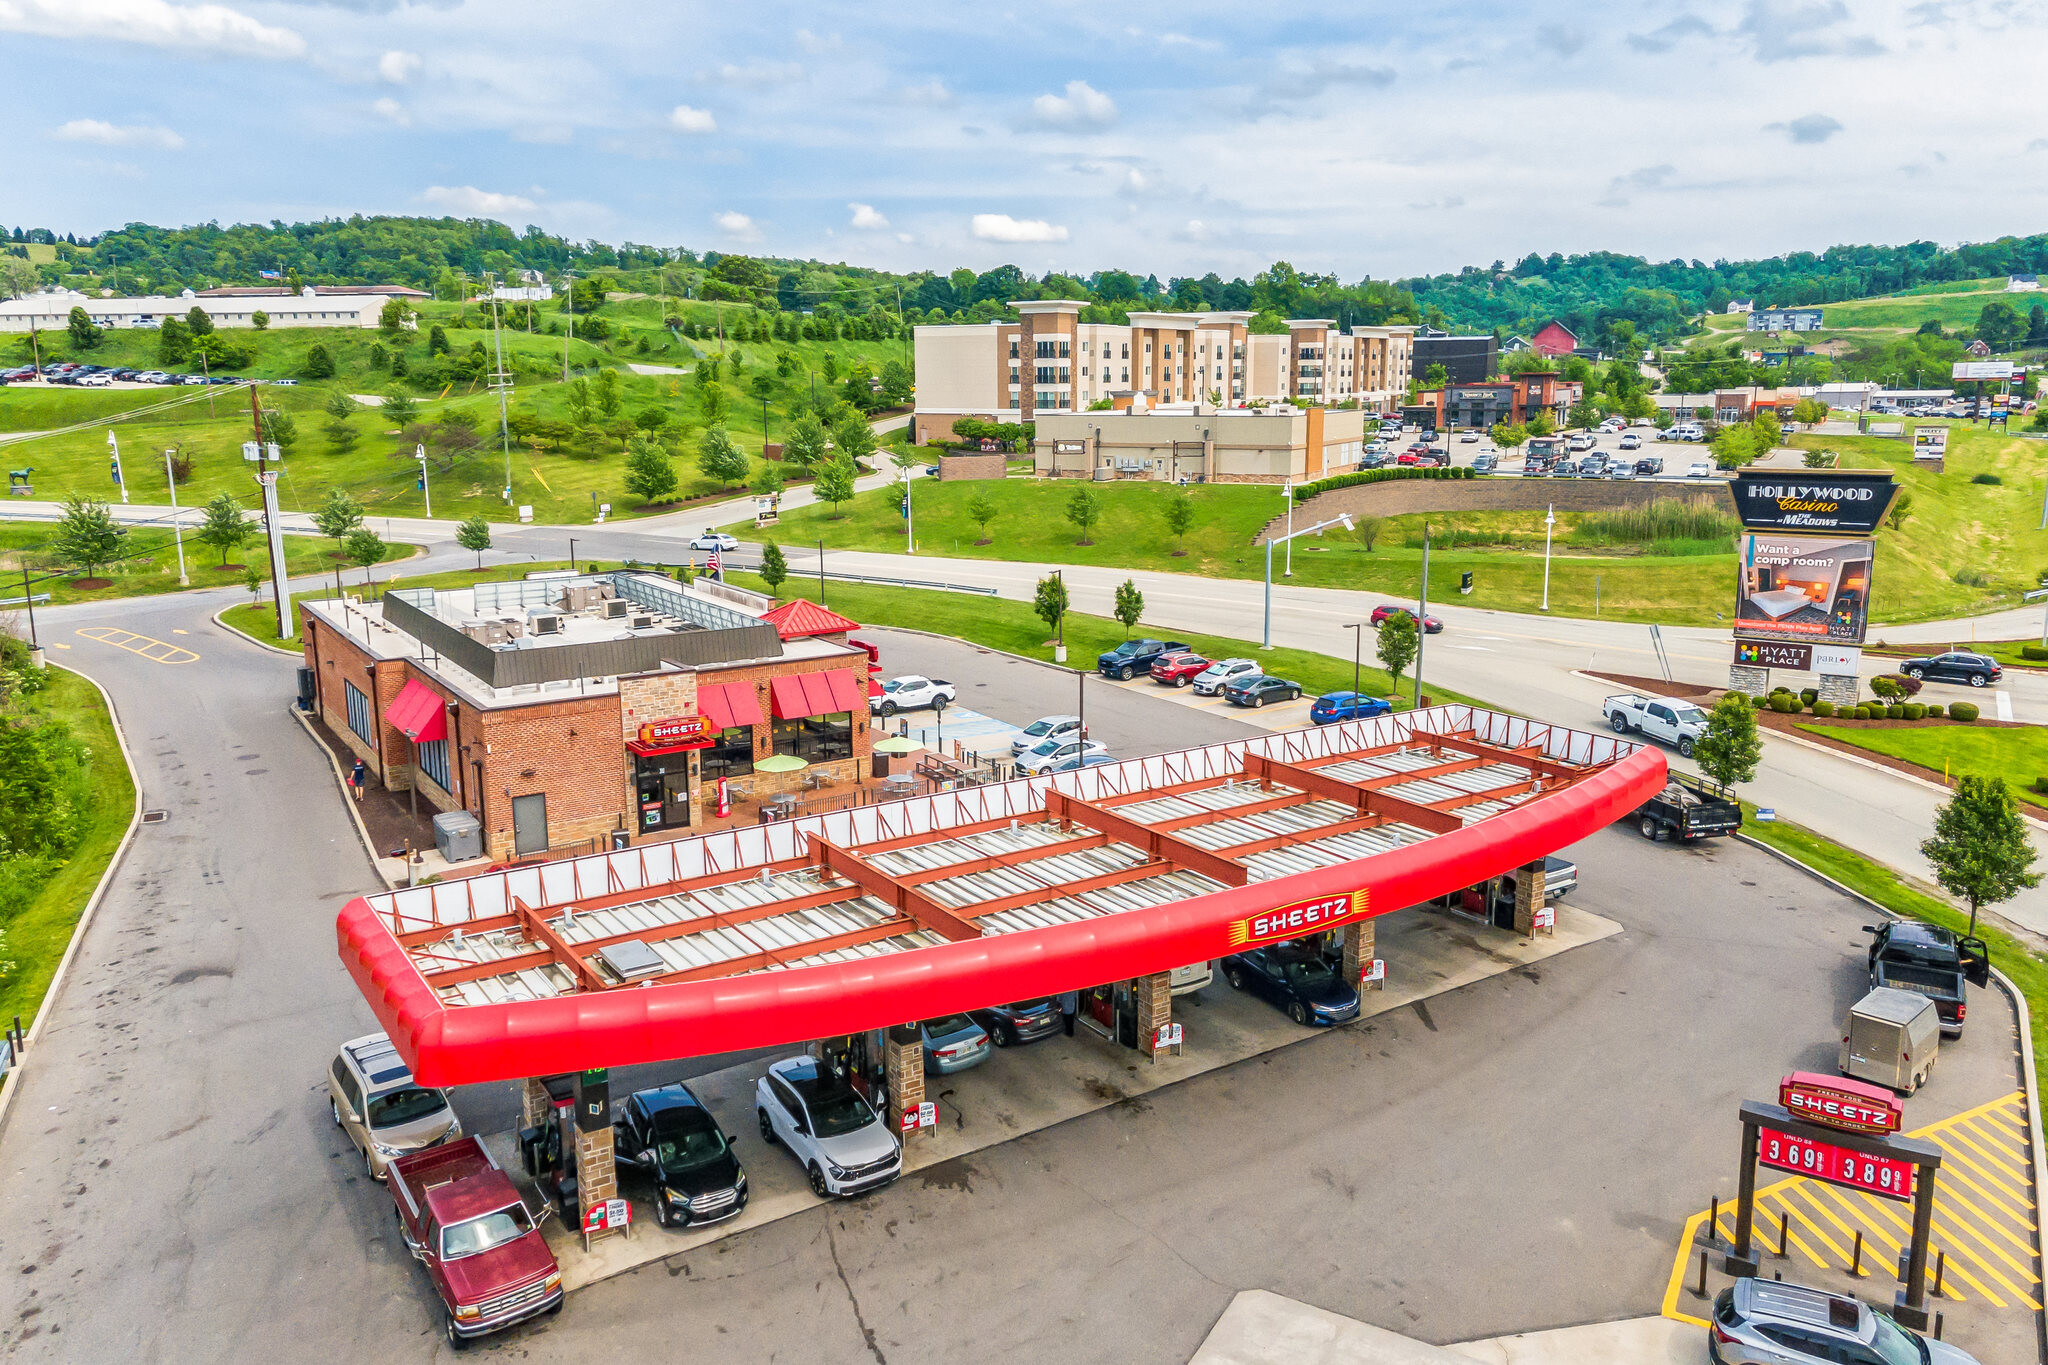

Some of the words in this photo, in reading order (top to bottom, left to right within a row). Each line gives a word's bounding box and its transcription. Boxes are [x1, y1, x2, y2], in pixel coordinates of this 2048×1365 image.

[1747, 485, 1874, 501] HOLLYWOOD
[1776, 496, 1839, 513] Casino
[1782, 514, 1839, 527] MEADOWS
[1756, 544, 1789, 555] Want
[1792, 547, 1800, 555] a
[1755, 556, 1790, 567] comp
[1792, 557, 1834, 567] room?
[1829, 625, 1855, 633] HYATT
[1760, 646, 1807, 659] HYATT
[1765, 656, 1800, 666] PLACE
[653, 722, 702, 737] SHEETZ
[1254, 898, 1347, 936] SHEETZ
[1817, 1089, 1840, 1098] FRESH
[1843, 1095, 1862, 1103] FOOD
[1790, 1092, 1888, 1125] SHEETZ
[1809, 1113, 1828, 1122] MADE
[1842, 1121, 1866, 1130] ORDER
[1783, 1133, 1803, 1143] UNLD
[1859, 1152, 1880, 1162] UNLD
